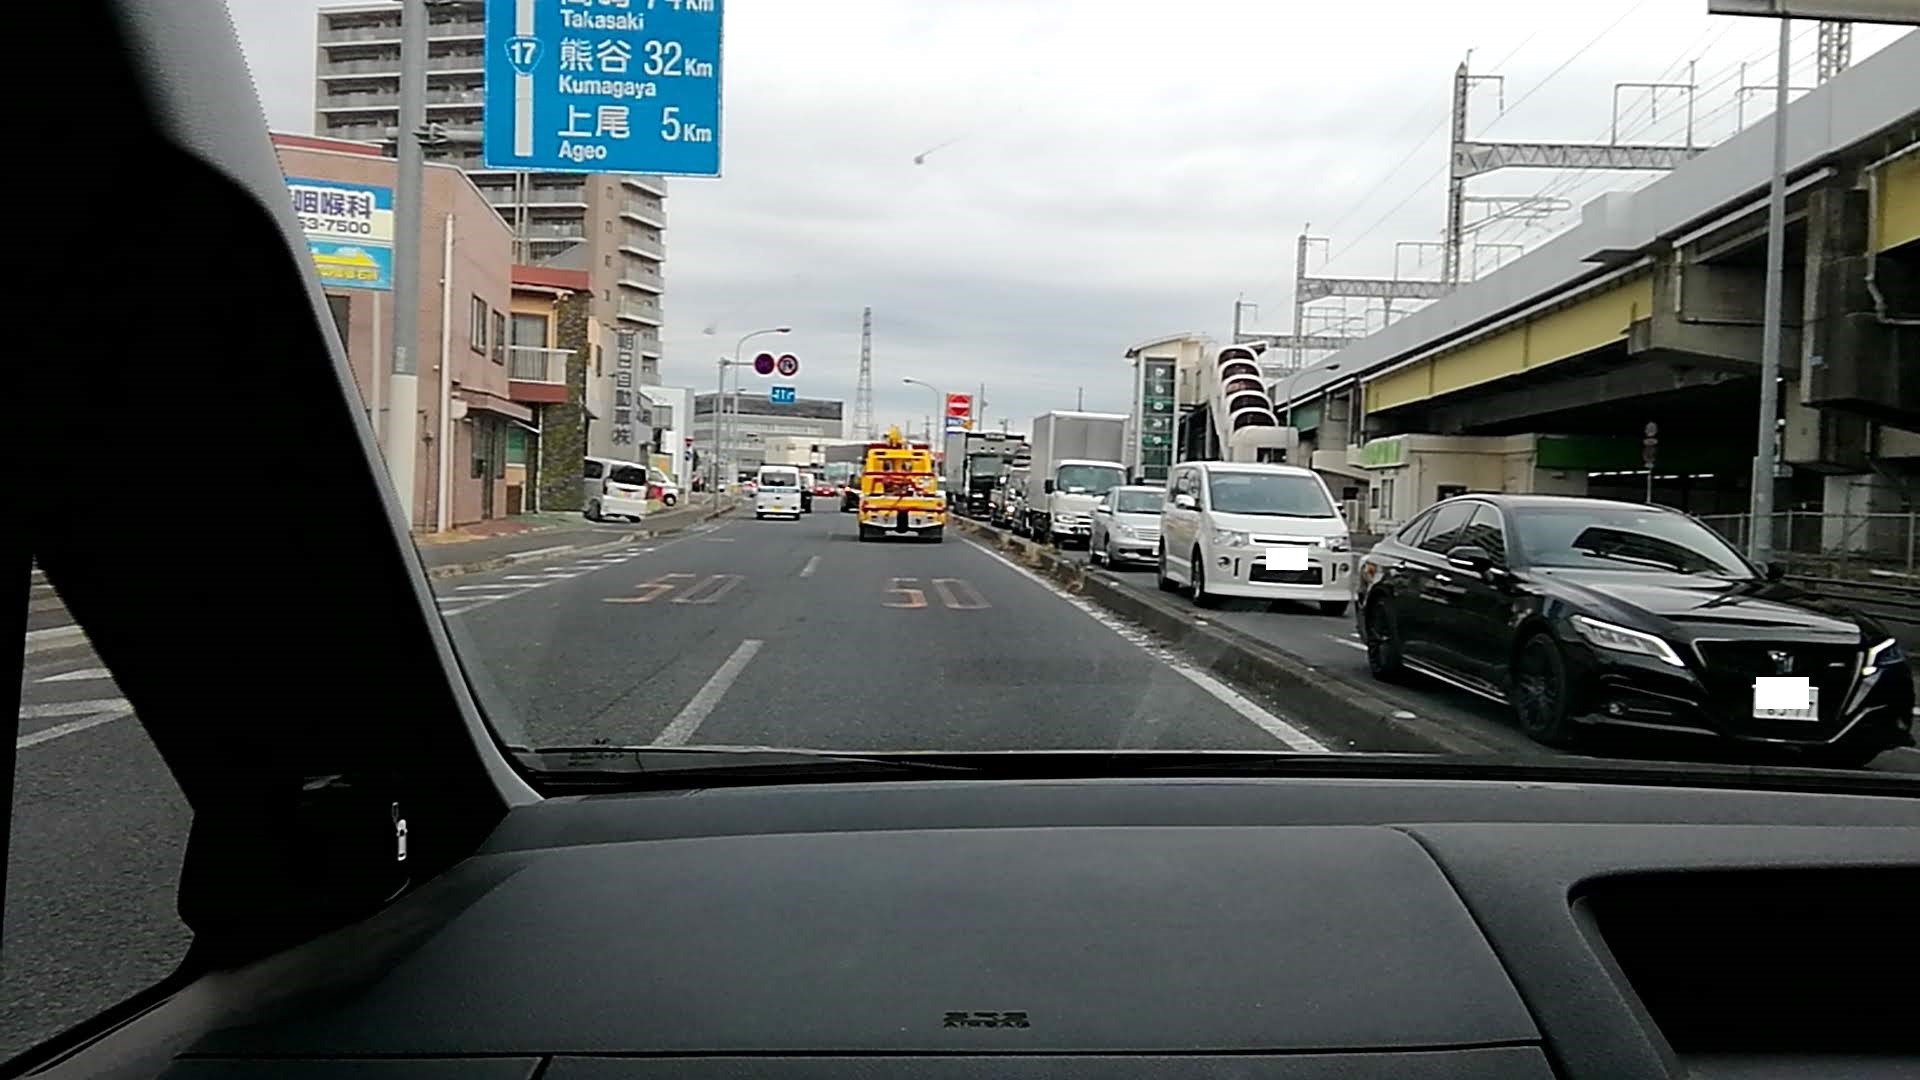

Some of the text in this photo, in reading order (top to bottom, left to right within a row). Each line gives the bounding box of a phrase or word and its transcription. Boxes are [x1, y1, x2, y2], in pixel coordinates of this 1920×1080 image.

[561, 10, 644, 30] Takasaki
[511, 42, 536, 64] 17
[559, 37, 631, 73] 熊谷
[559, 75, 656, 98] Kumagaya
[557, 104, 630, 139] 上尾
[558, 141, 607, 162] Ageo
[881, 576, 992, 609] 50
